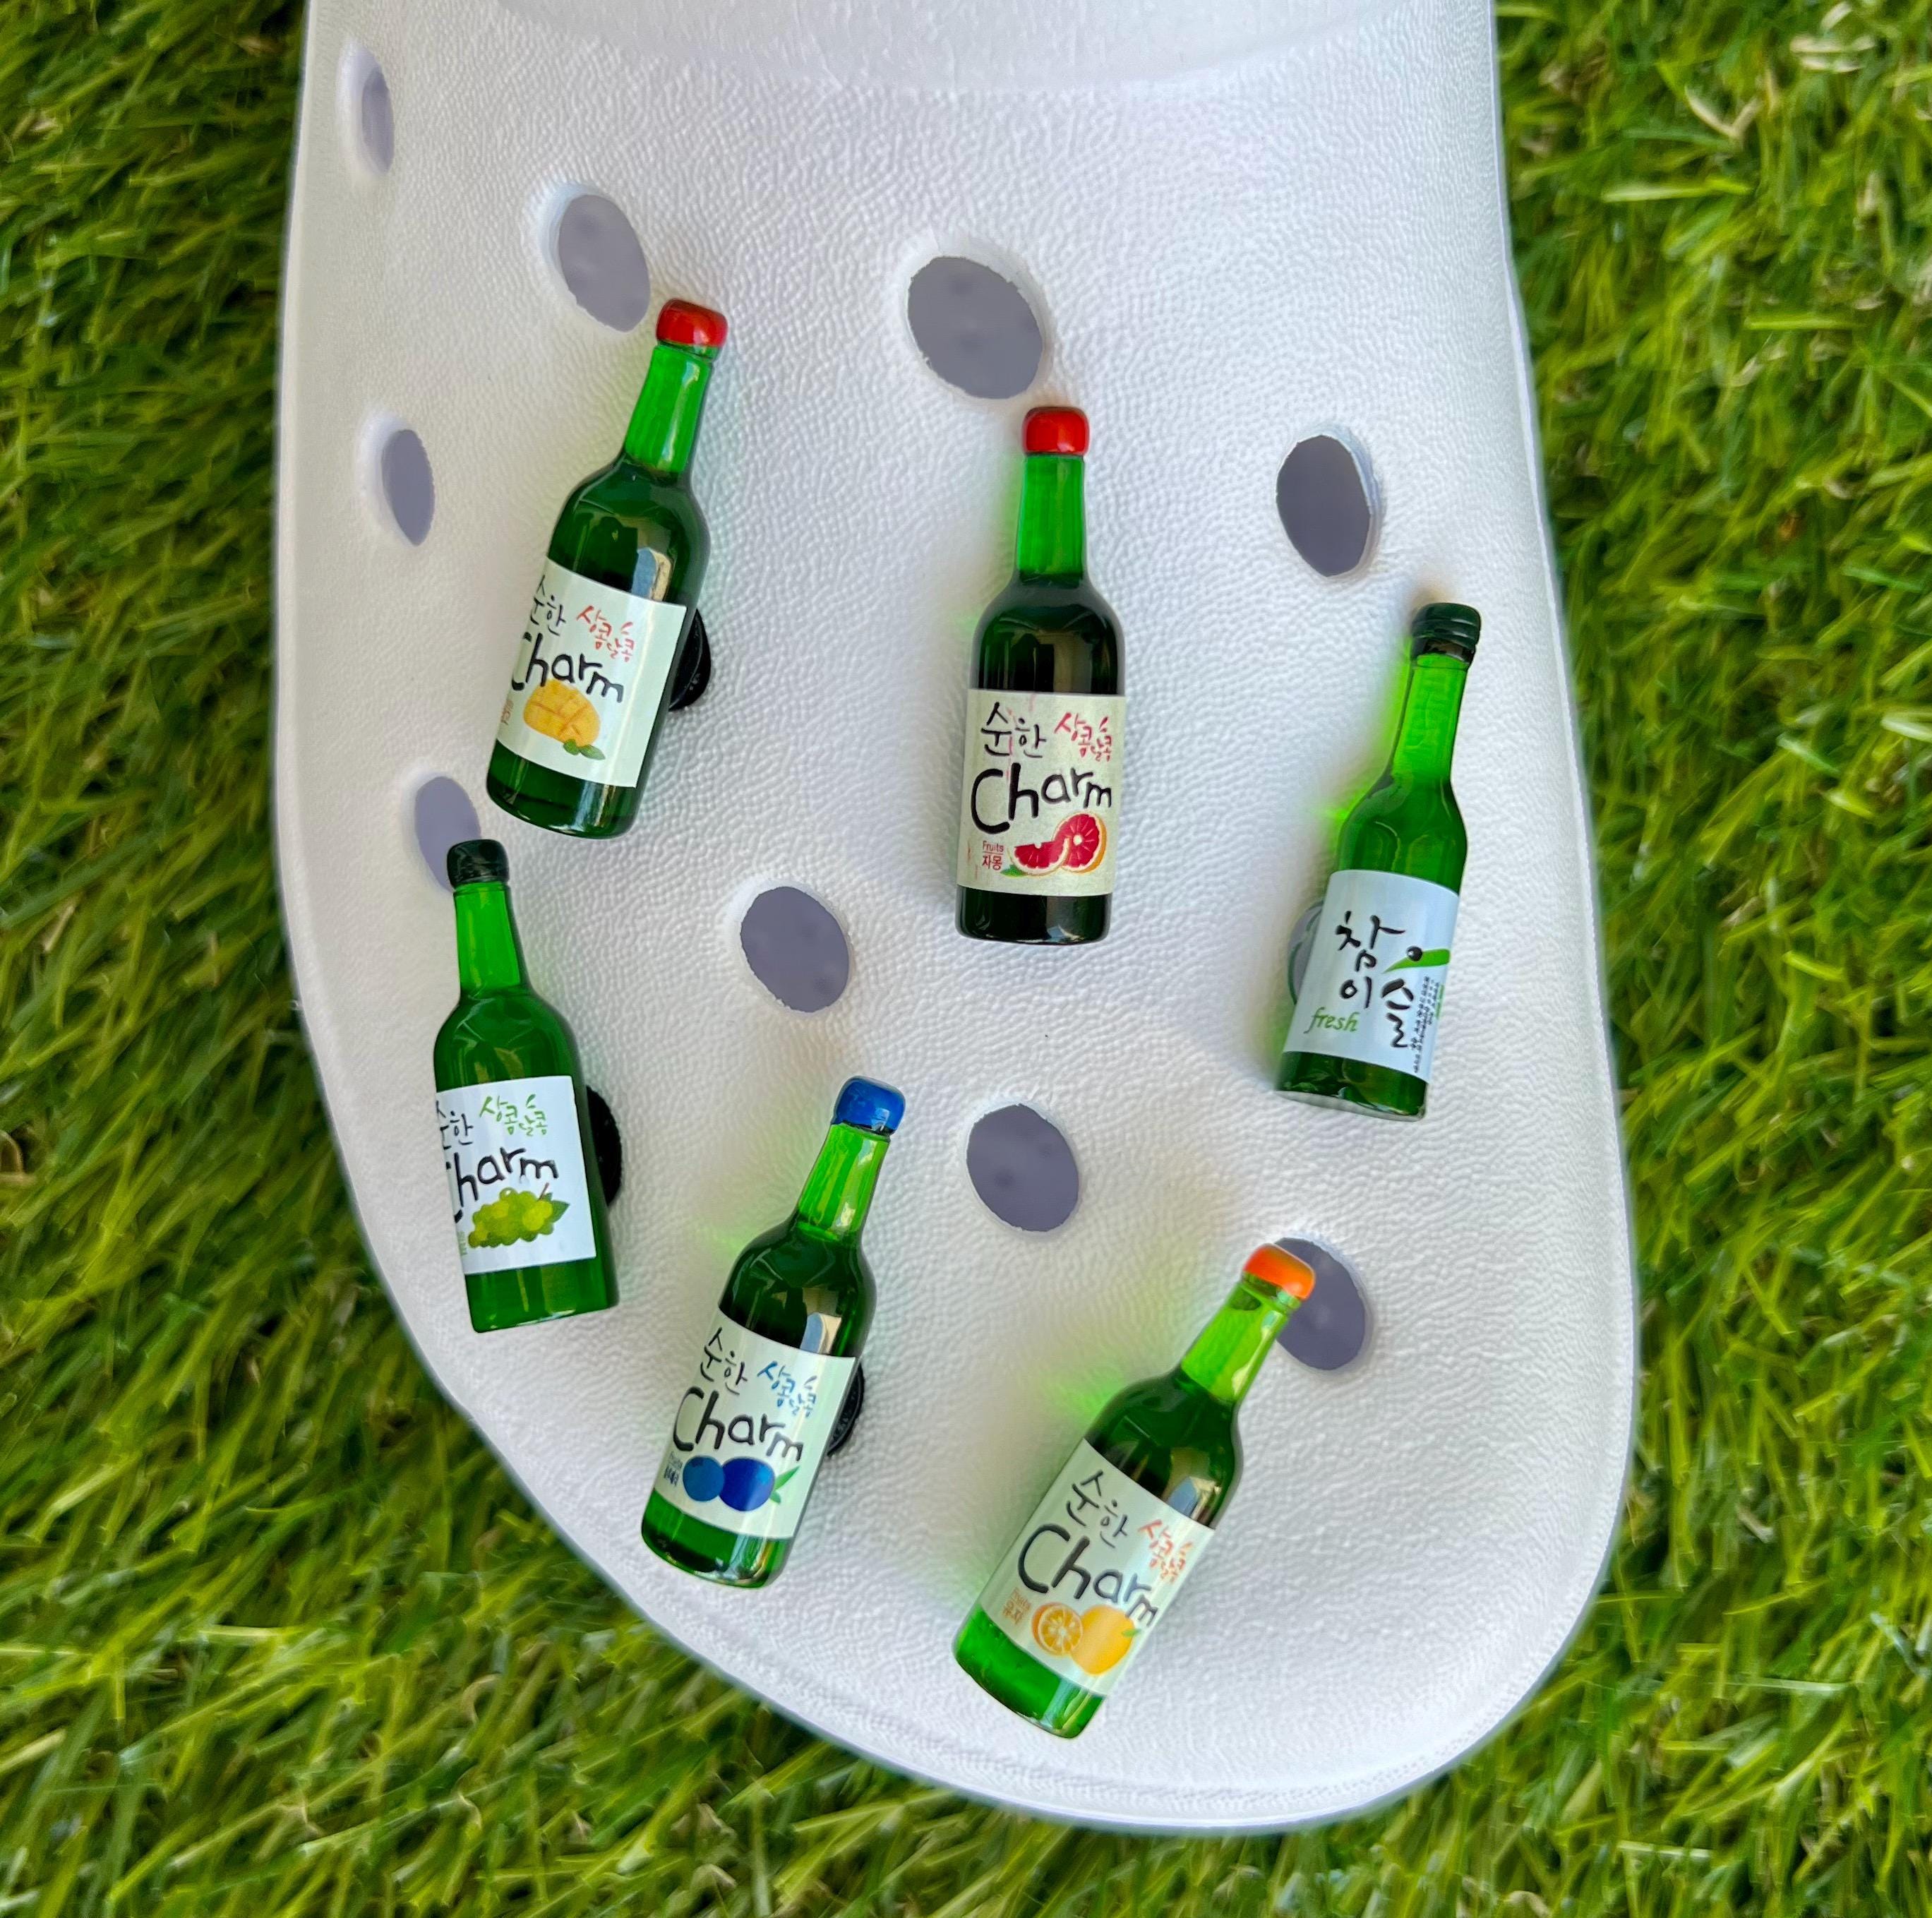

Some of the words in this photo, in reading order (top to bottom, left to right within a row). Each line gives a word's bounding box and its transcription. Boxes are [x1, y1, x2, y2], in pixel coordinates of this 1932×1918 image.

[980, 702, 1046, 758] 순한
[971, 762, 1112, 834] Charm
[982, 854, 1002, 870] 자몽
[1303, 1007, 1360, 1034] fresh
[446, 1147, 559, 1223] harm
[700, 1327, 748, 1396] 순한
[673, 1386, 803, 1461] Charm
[1066, 1469, 1128, 1548] 순한
[1017, 1523, 1159, 1626] Charm
